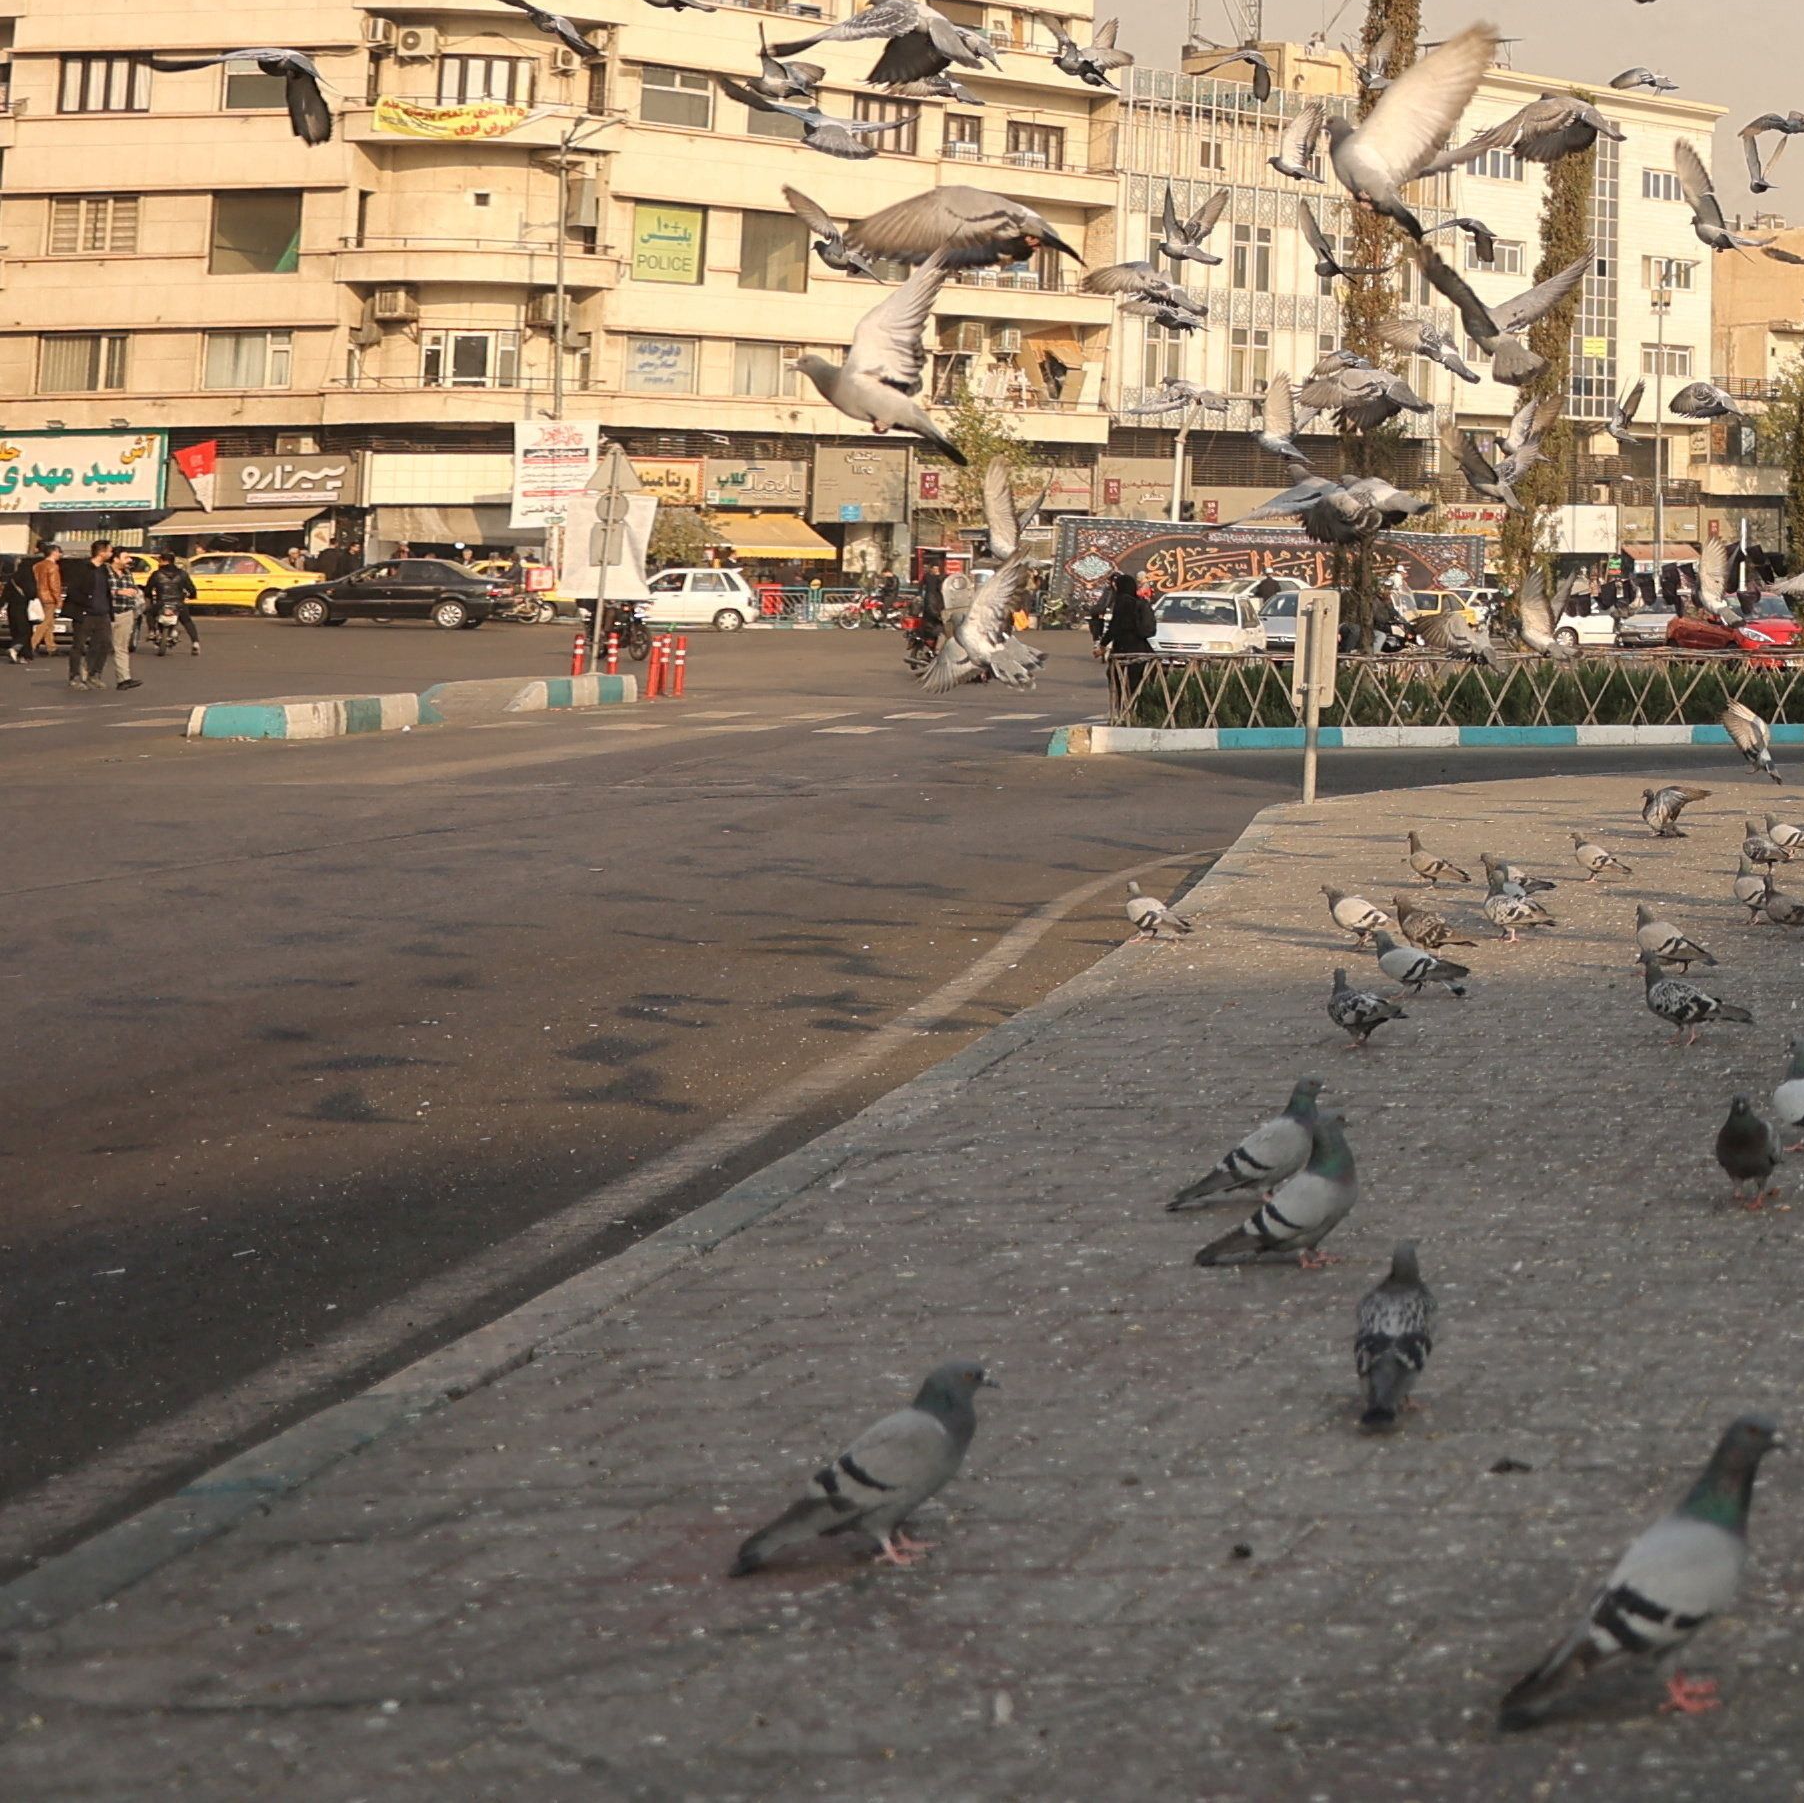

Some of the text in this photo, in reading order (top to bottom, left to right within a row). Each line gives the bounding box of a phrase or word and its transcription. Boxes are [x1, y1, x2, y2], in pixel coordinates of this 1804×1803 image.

[640, 227, 692, 248] پلیس
[637, 254, 692, 273] POLICE
[120, 433, 156, 465] آش
[82, 461, 136, 493] سید
